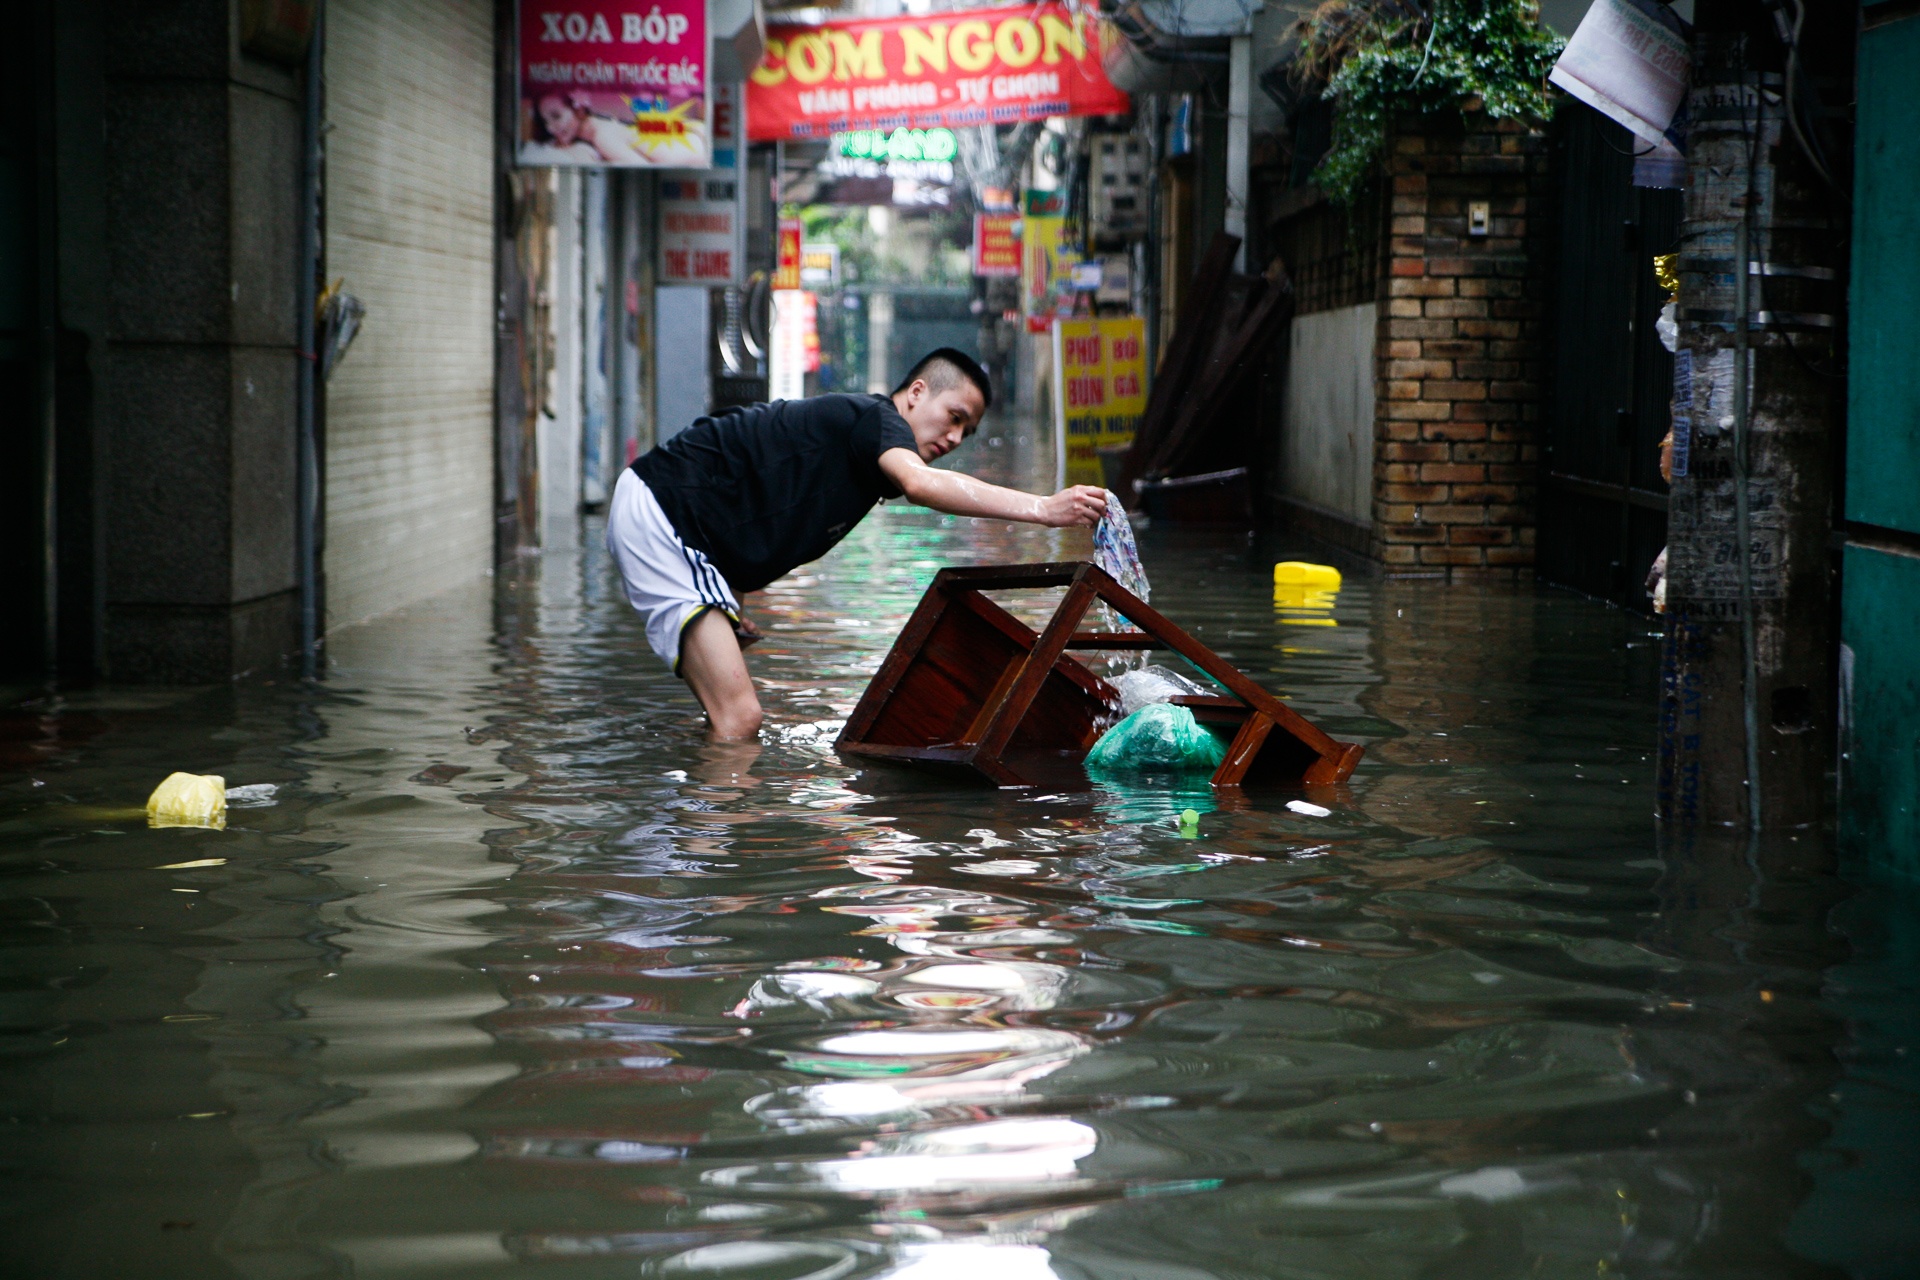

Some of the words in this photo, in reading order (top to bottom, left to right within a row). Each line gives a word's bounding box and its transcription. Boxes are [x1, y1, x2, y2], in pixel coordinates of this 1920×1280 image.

[539, 13, 614, 43] XOA
[621, 5, 689, 44] BÓP
[751, 28, 886, 86] CƠM
[899, 12, 1087, 77] NGON
[798, 87, 849, 115] VĂN
[853, 80, 938, 112] PHÒNG
[992, 71, 1059, 99] CHỌN
[1065, 323, 1101, 367] PHỞ
[1112, 331, 1138, 361] BÒ
[1067, 370, 1103, 406] BÚN
[1113, 370, 1139, 397] GÀ
